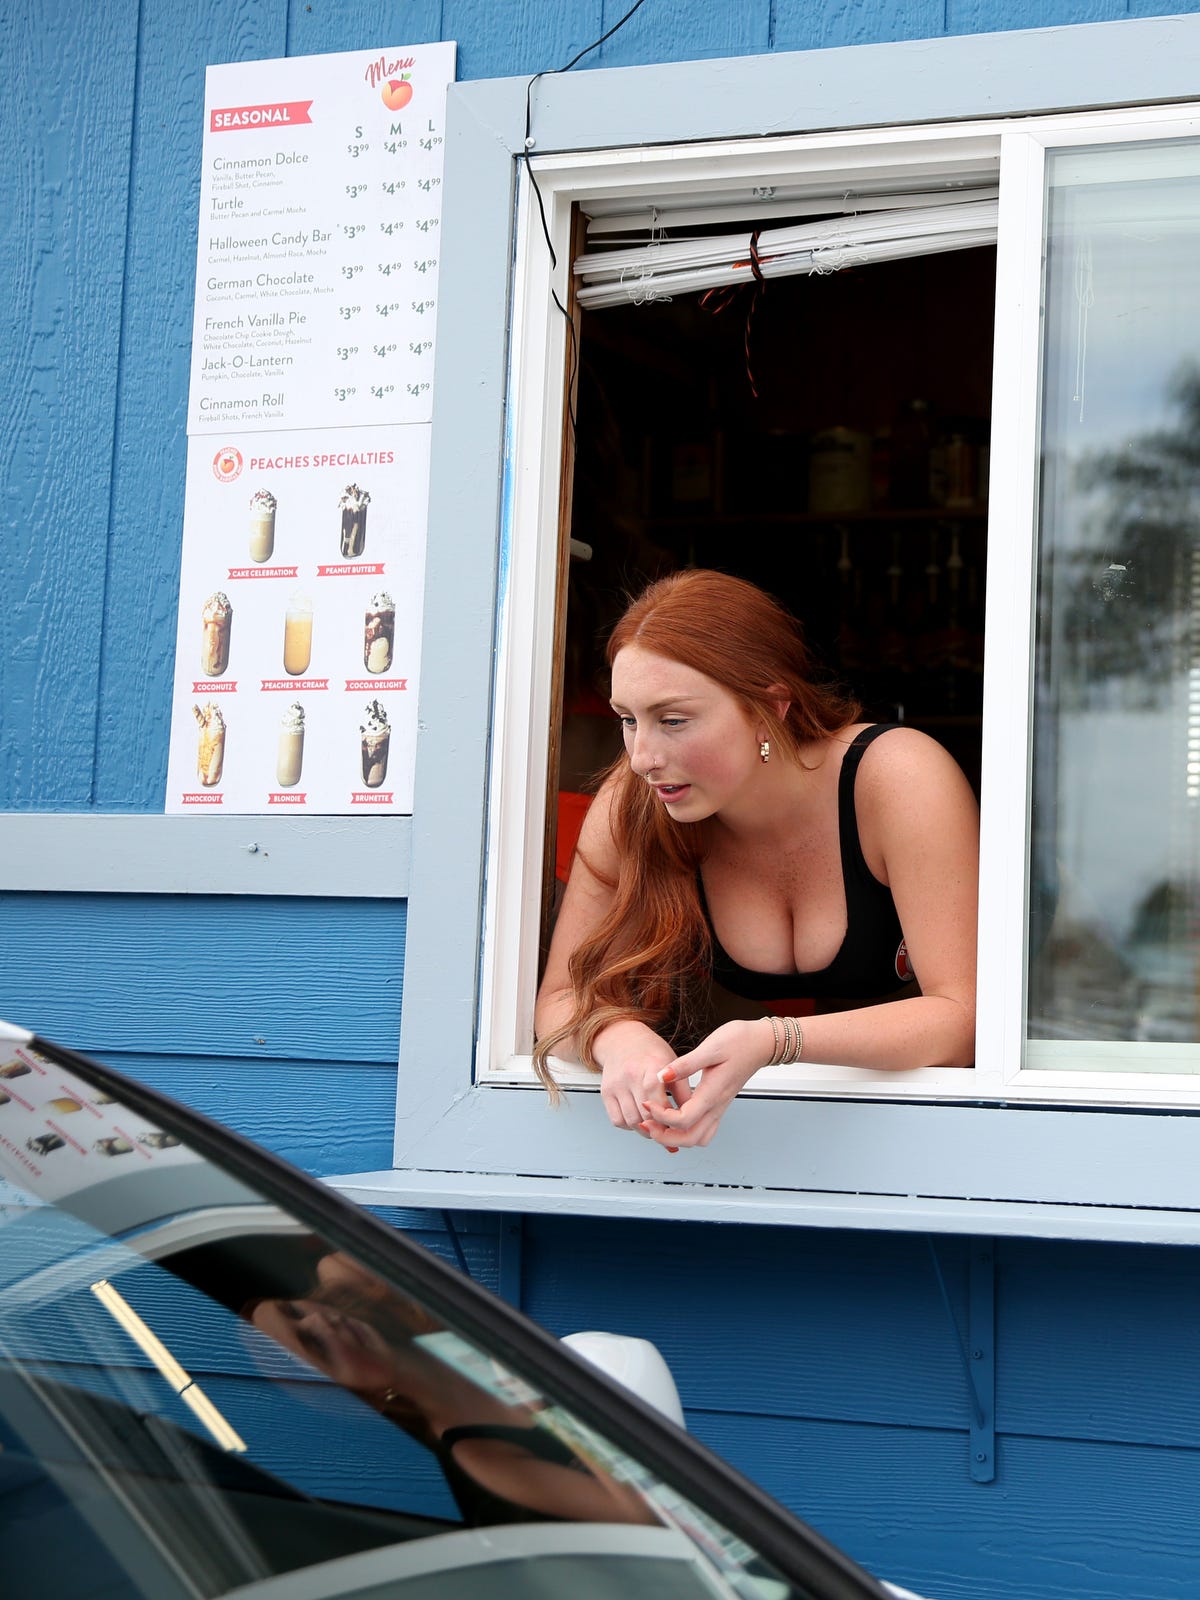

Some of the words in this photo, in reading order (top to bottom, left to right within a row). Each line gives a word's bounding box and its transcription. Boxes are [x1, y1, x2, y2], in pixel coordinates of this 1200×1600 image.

[364, 55, 416, 88] Menu
[215, 107, 291, 128] SEASONAL
[356, 126, 362, 138] S
[390, 123, 401, 135] M
[429, 120, 435, 131] L
[214, 158, 271, 170] Cinnamon
[276, 152, 308, 165] Dolce
[212, 196, 243, 210] Turtle
[210, 237, 267, 250] Halloween
[272, 231, 308, 247] Candy
[313, 230, 331, 242] Bar
[207, 278, 252, 290] German
[257, 272, 314, 286] Chocolate
[206, 316, 243, 330] French
[248, 313, 284, 326] Vanilla
[289, 312, 306, 324] Pie
[202, 355, 293, 372] Jack-O-Lantern
[200, 398, 257, 410] Cinnamon
[263, 393, 284, 406] Roll
[251, 456, 309, 469] PEACHES
[313, 452, 393, 467] SPECIALTIES
[232, 570, 251, 578] CAKE
[250, 568, 294, 577] CELEBRATION
[325, 567, 350, 575] PEANUT
[351, 566, 376, 574] BUTTER
[197, 683, 233, 691] COCONUTZ
[300, 681, 325, 689] CREAM
[349, 682, 374, 690] COCOA
[374, 681, 403, 689] DELIGHT
[355, 794, 389, 802] BRUNETTE
